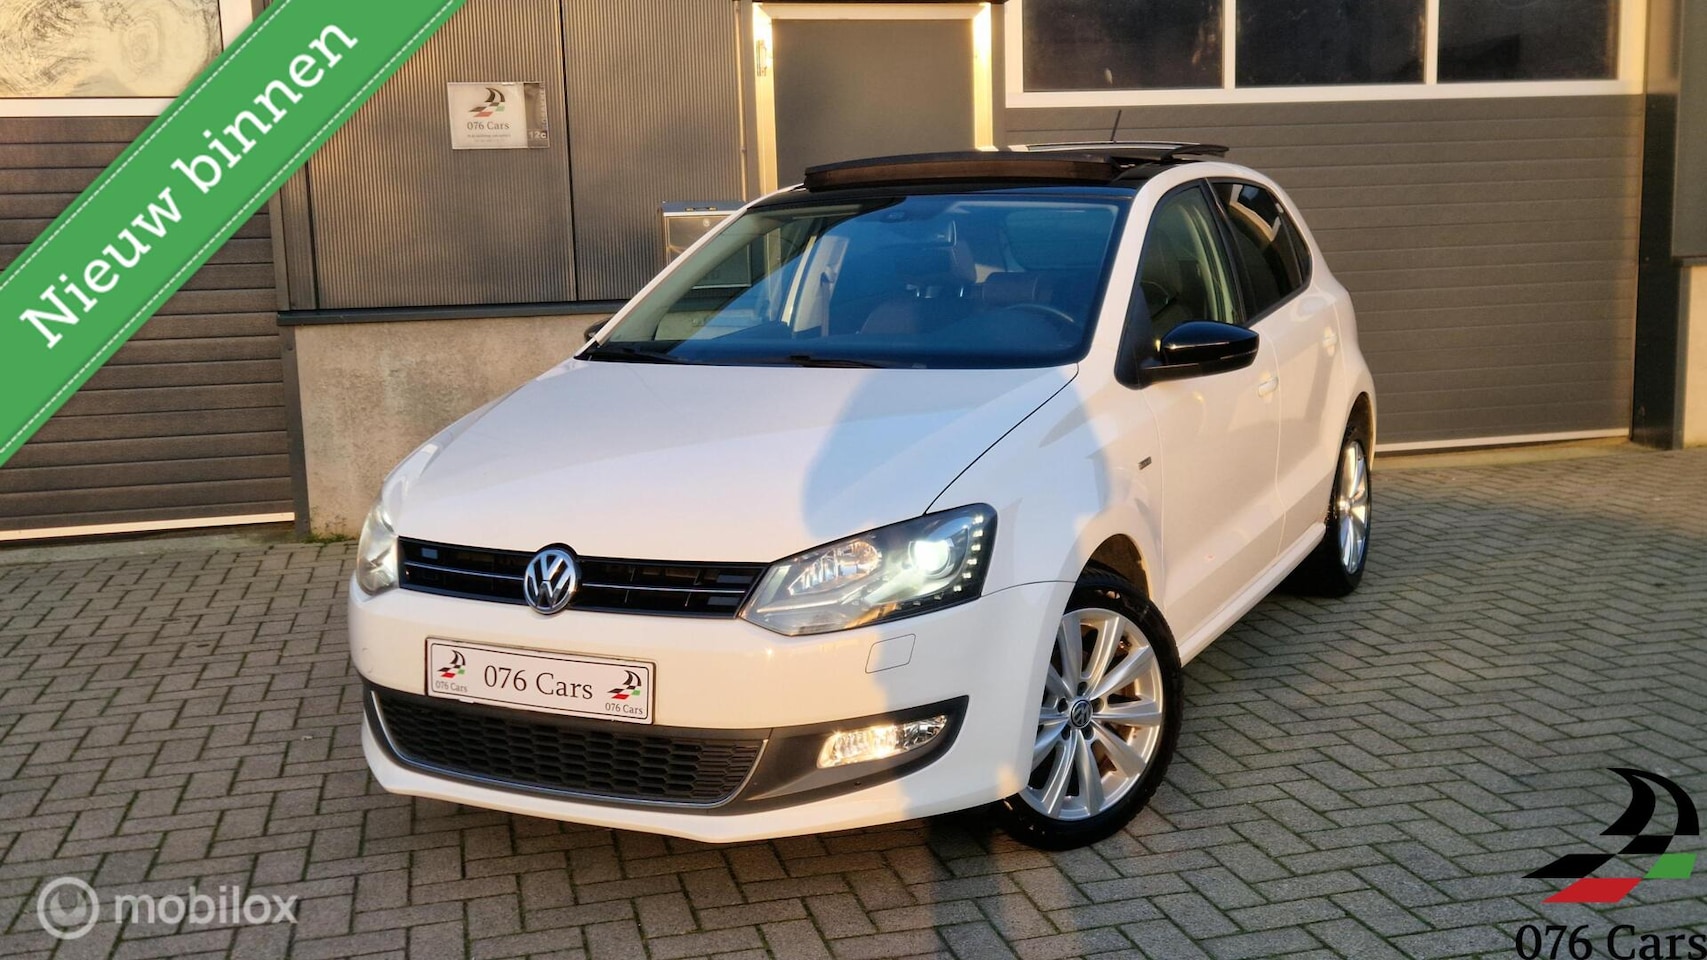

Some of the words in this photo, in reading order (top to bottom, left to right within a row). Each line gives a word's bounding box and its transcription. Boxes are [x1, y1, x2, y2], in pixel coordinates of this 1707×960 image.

[467, 121, 485, 130] 076
[487, 121, 510, 130] Cars
[524, 548, 577, 615] VW
[435, 680, 450, 691] 076
[450, 682, 468, 693] Cars
[484, 665, 528, 692] 076
[535, 672, 594, 700] Cars
[605, 702, 621, 713] 076
[622, 703, 644, 715] Cars
